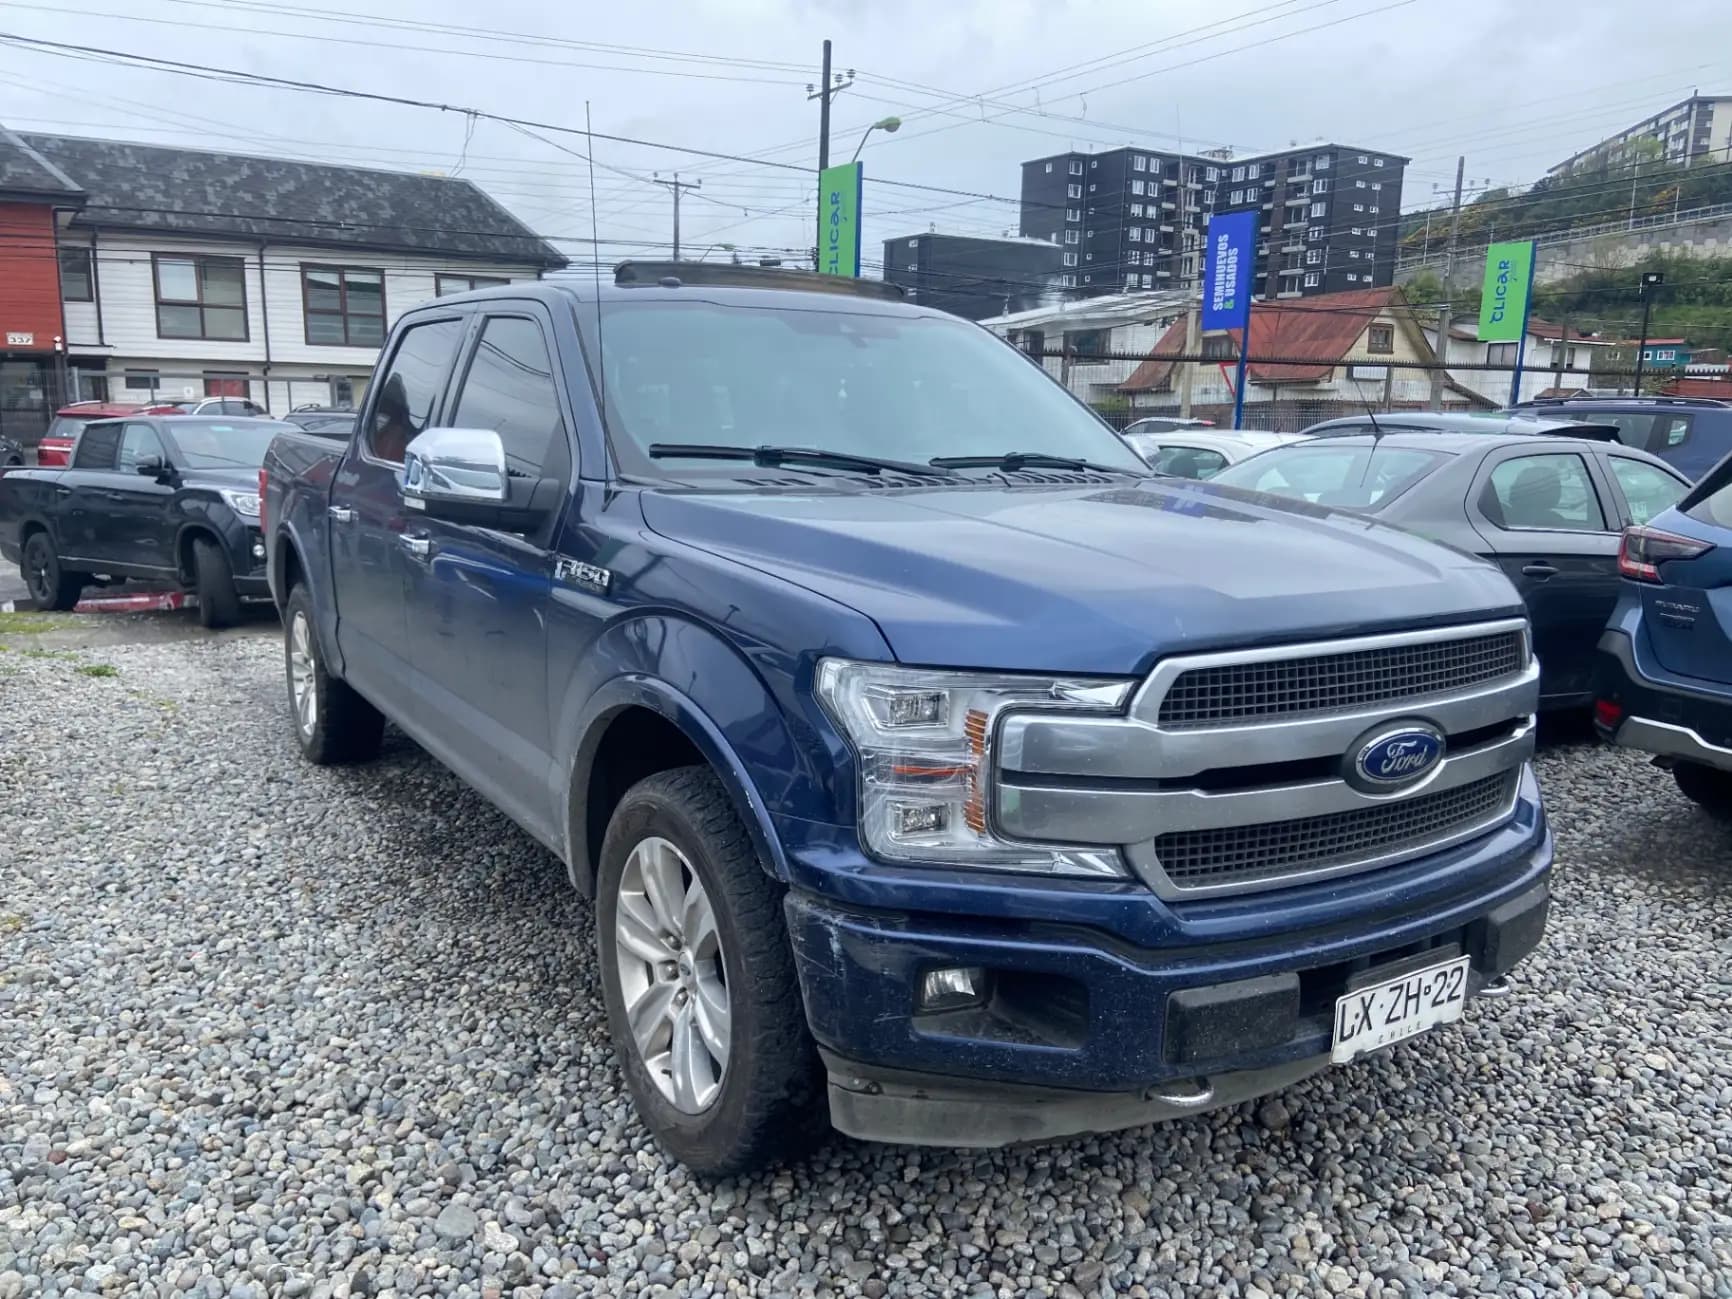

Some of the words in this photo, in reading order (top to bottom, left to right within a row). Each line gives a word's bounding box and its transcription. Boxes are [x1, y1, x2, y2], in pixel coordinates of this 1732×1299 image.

[1213, 234, 1229, 311] SEMINUEVOS
[1225, 247, 1238, 297] USADOS
[1381, 740, 1428, 774] Ford
